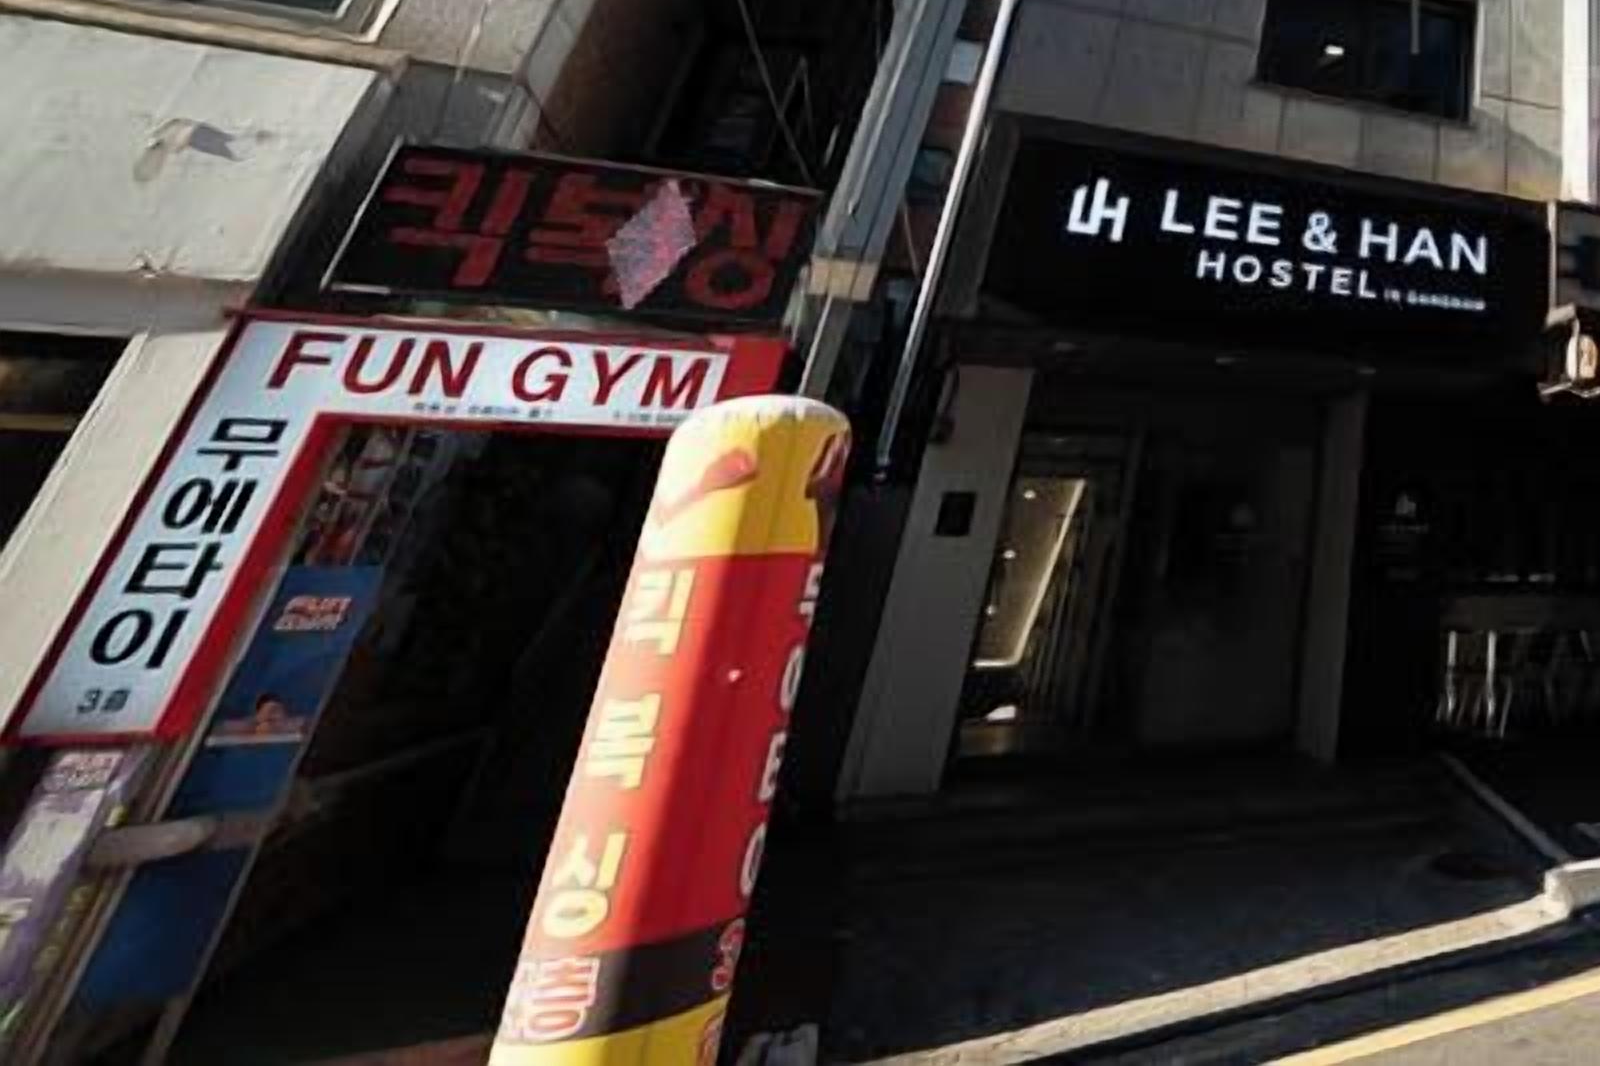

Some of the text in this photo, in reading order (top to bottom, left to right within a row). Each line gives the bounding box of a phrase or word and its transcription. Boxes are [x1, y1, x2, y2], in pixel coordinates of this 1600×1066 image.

[1160, 189, 1487, 275] LEE & HAN
[1196, 249, 1377, 299] HOSTEL
[266, 331, 712, 411] FUN GYM
[89, 418, 288, 670] 무에타이
